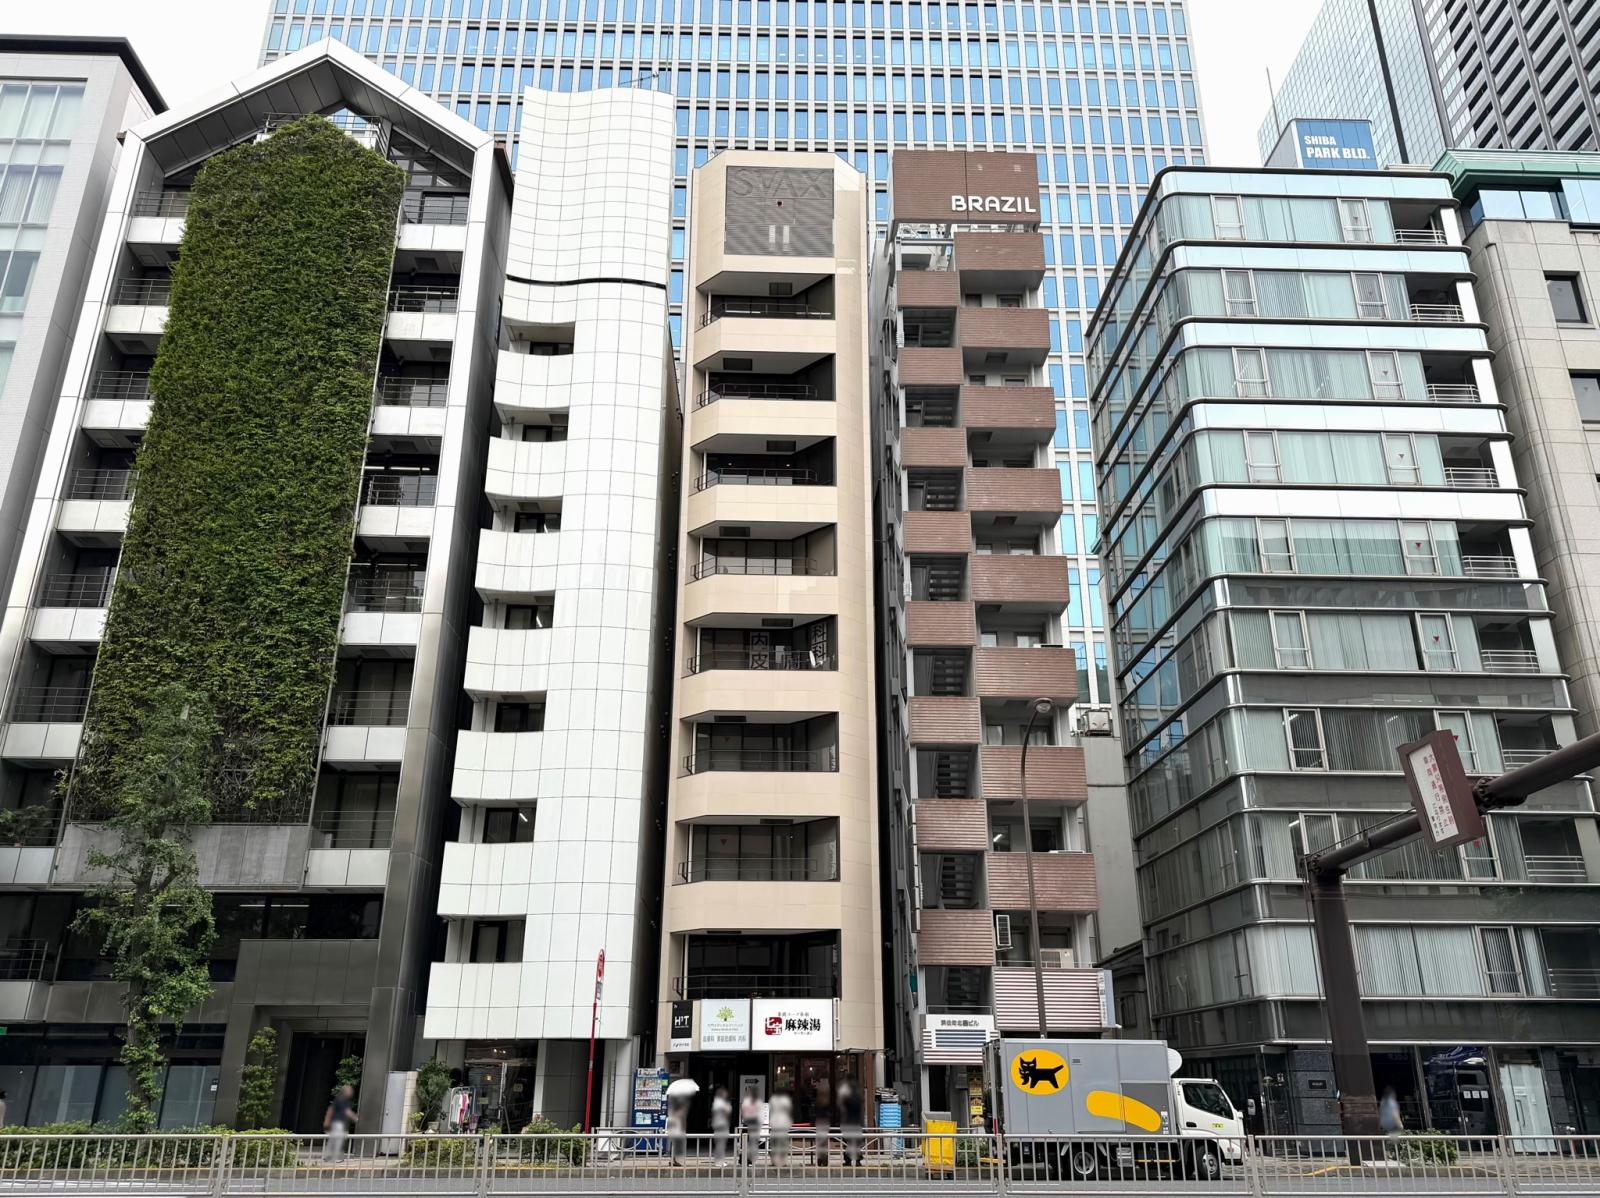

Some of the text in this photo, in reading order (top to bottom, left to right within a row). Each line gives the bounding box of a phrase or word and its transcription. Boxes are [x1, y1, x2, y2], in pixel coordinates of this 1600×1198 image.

[1303, 135, 1337, 146] SHIBA
[1306, 147, 1371, 160] PARK BLD.
[732, 168, 828, 198] SVAX
[951, 195, 1037, 213] BRAZIL
[784, 1017, 821, 1032] 麻辣湯
